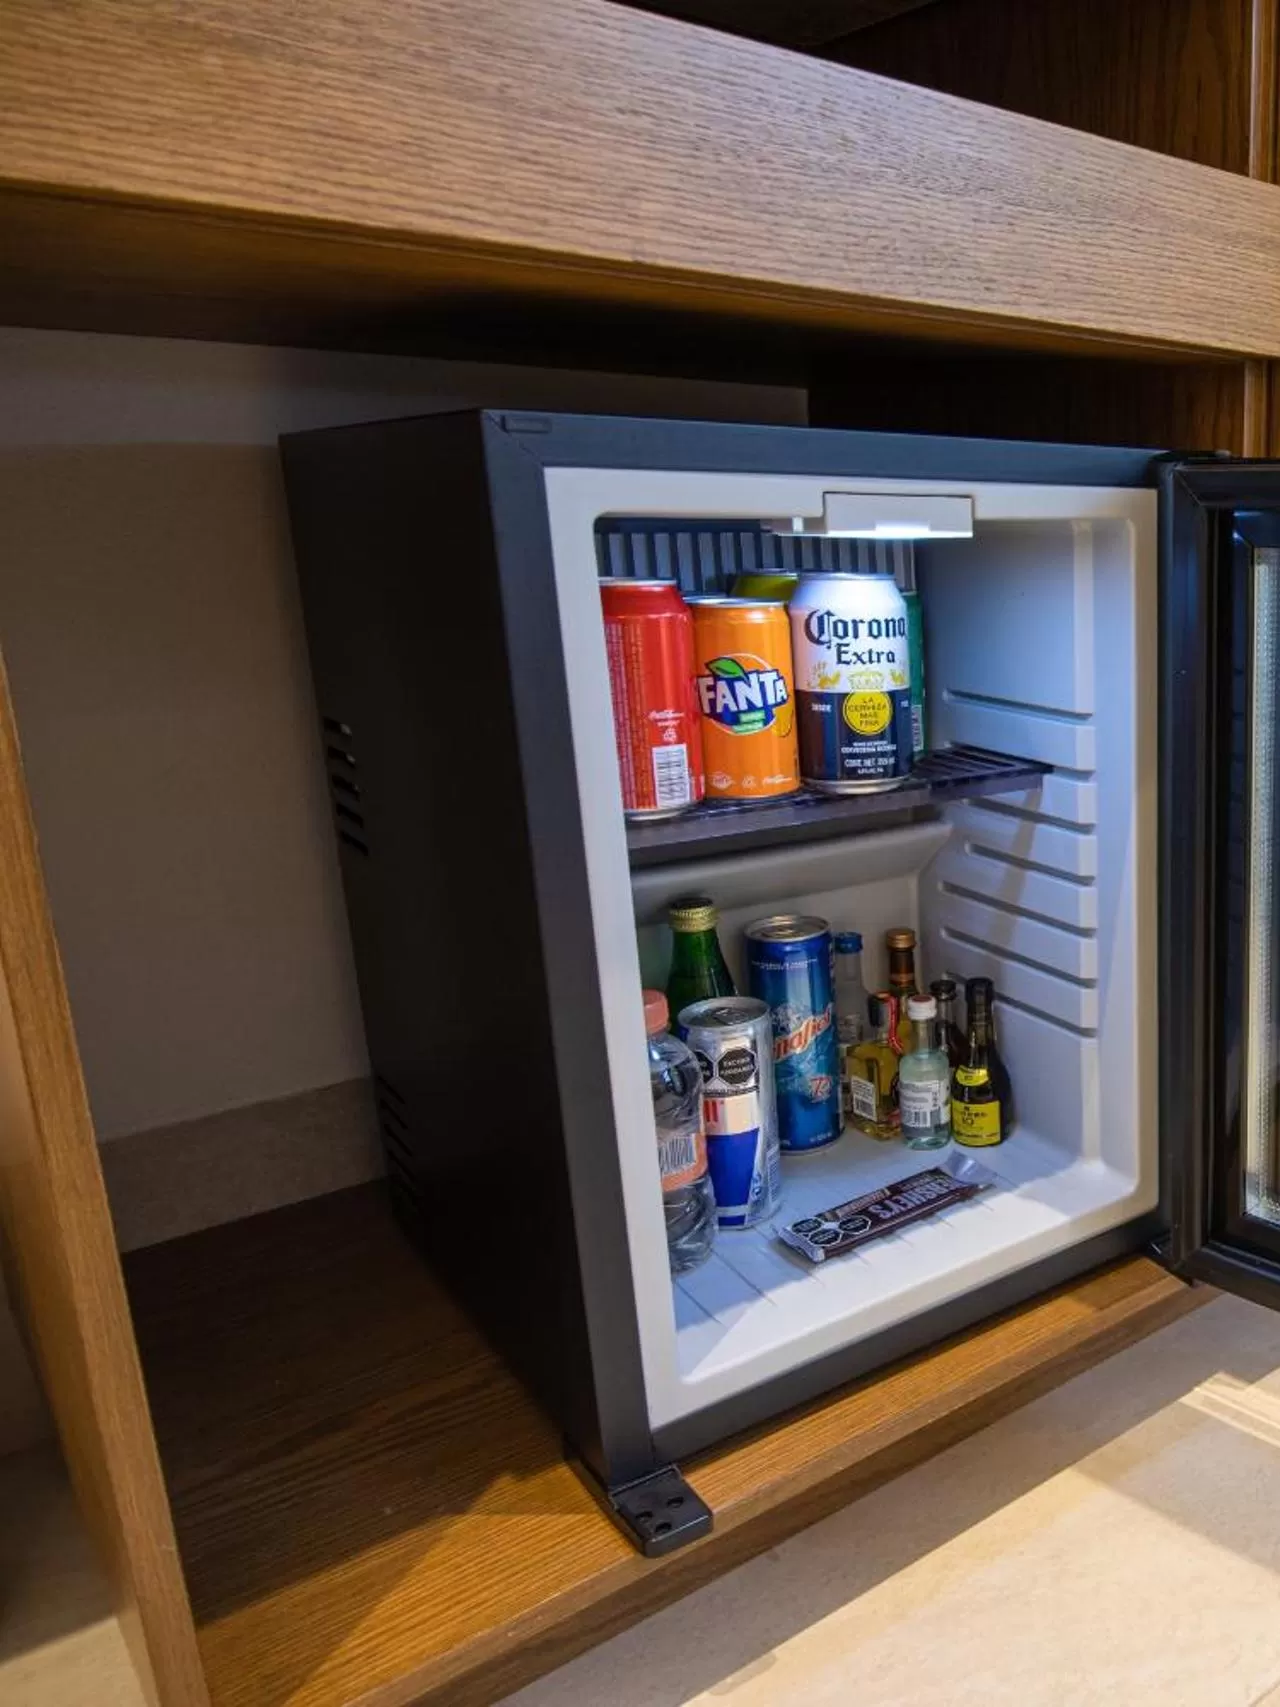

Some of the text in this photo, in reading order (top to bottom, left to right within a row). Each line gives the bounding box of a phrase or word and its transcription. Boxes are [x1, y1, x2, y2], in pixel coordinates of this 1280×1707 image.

[804, 609, 906, 650] Corona
[834, 642, 896, 665] Extra
[697, 671, 788, 714] FANTA
